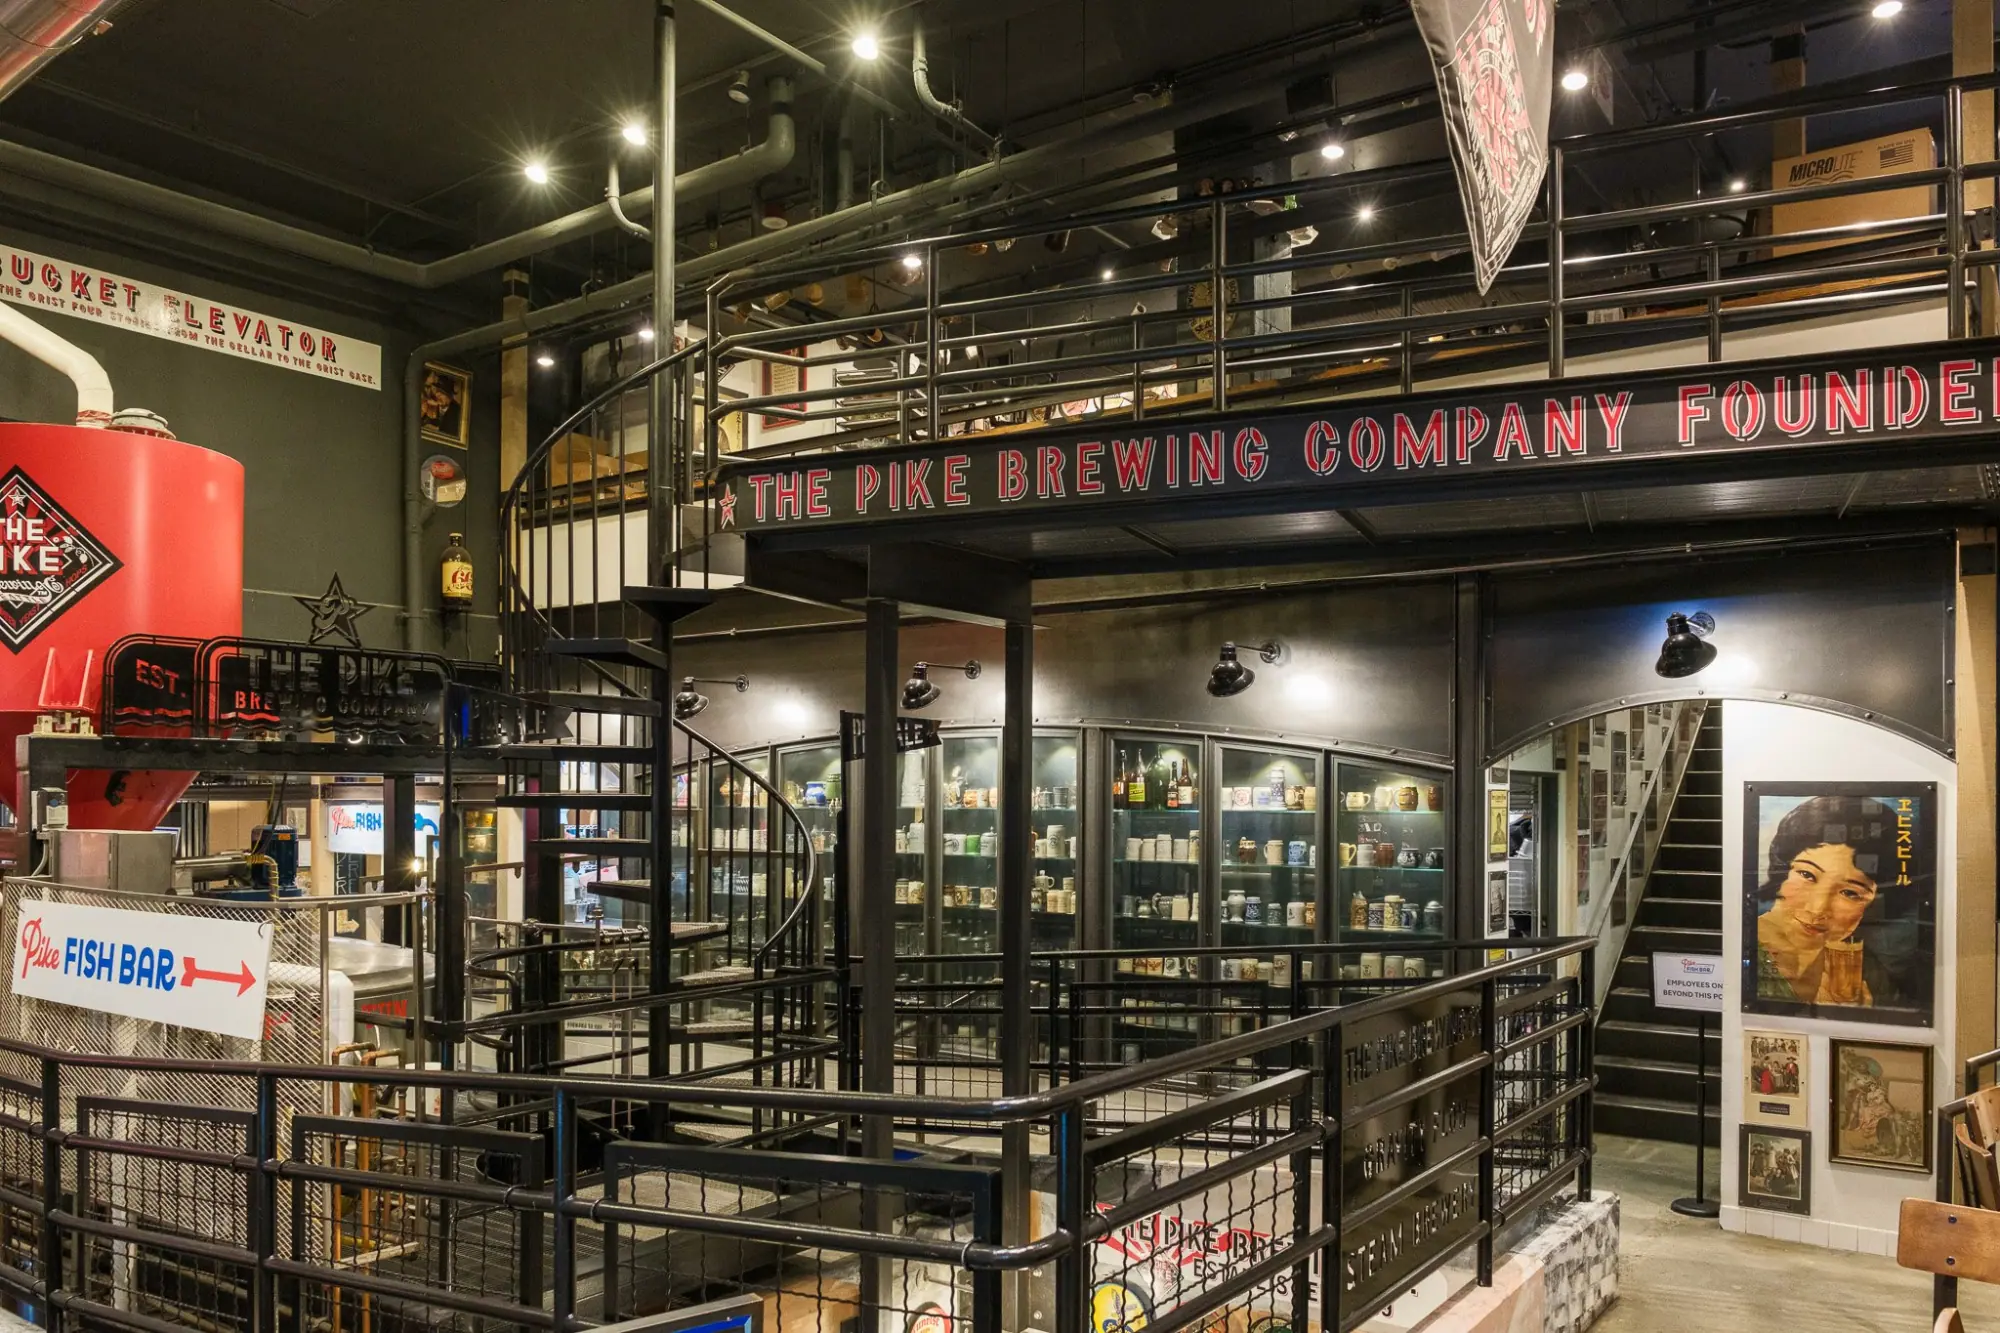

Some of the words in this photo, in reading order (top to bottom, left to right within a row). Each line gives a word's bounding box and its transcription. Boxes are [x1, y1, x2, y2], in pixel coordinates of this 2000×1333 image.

[1789, 151, 1857, 182] MICROLITE
[0, 254, 141, 312] UCKET
[0, 285, 22, 299] THE
[72, 301, 103, 318] FOUR
[205, 335, 225, 348] THE
[277, 352, 290, 363] TO
[293, 357, 312, 369] THE
[749, 468, 831, 522] THE
[856, 456, 970, 512] PIKE
[998, 426, 1268, 502] BREWING
[1304, 390, 1633, 477] COMPANY
[1678, 357, 2000, 448] FOUNDE
[135, 658, 187, 699] EST.
[247, 646, 322, 692] THE
[338, 653, 416, 697] PIKE
[21, 917, 60, 980] Pike
[64, 937, 114, 982] FISH
[119, 943, 176, 992] BAR
[1663, 989, 1694, 998] BEYOND
[1695, 992, 1712, 1000] THIS
[1666, 979, 1710, 988] EMPLOYEES
[1164, 1218, 1219, 1255] PIKE
[1347, 1221, 1404, 1292] STEAM
